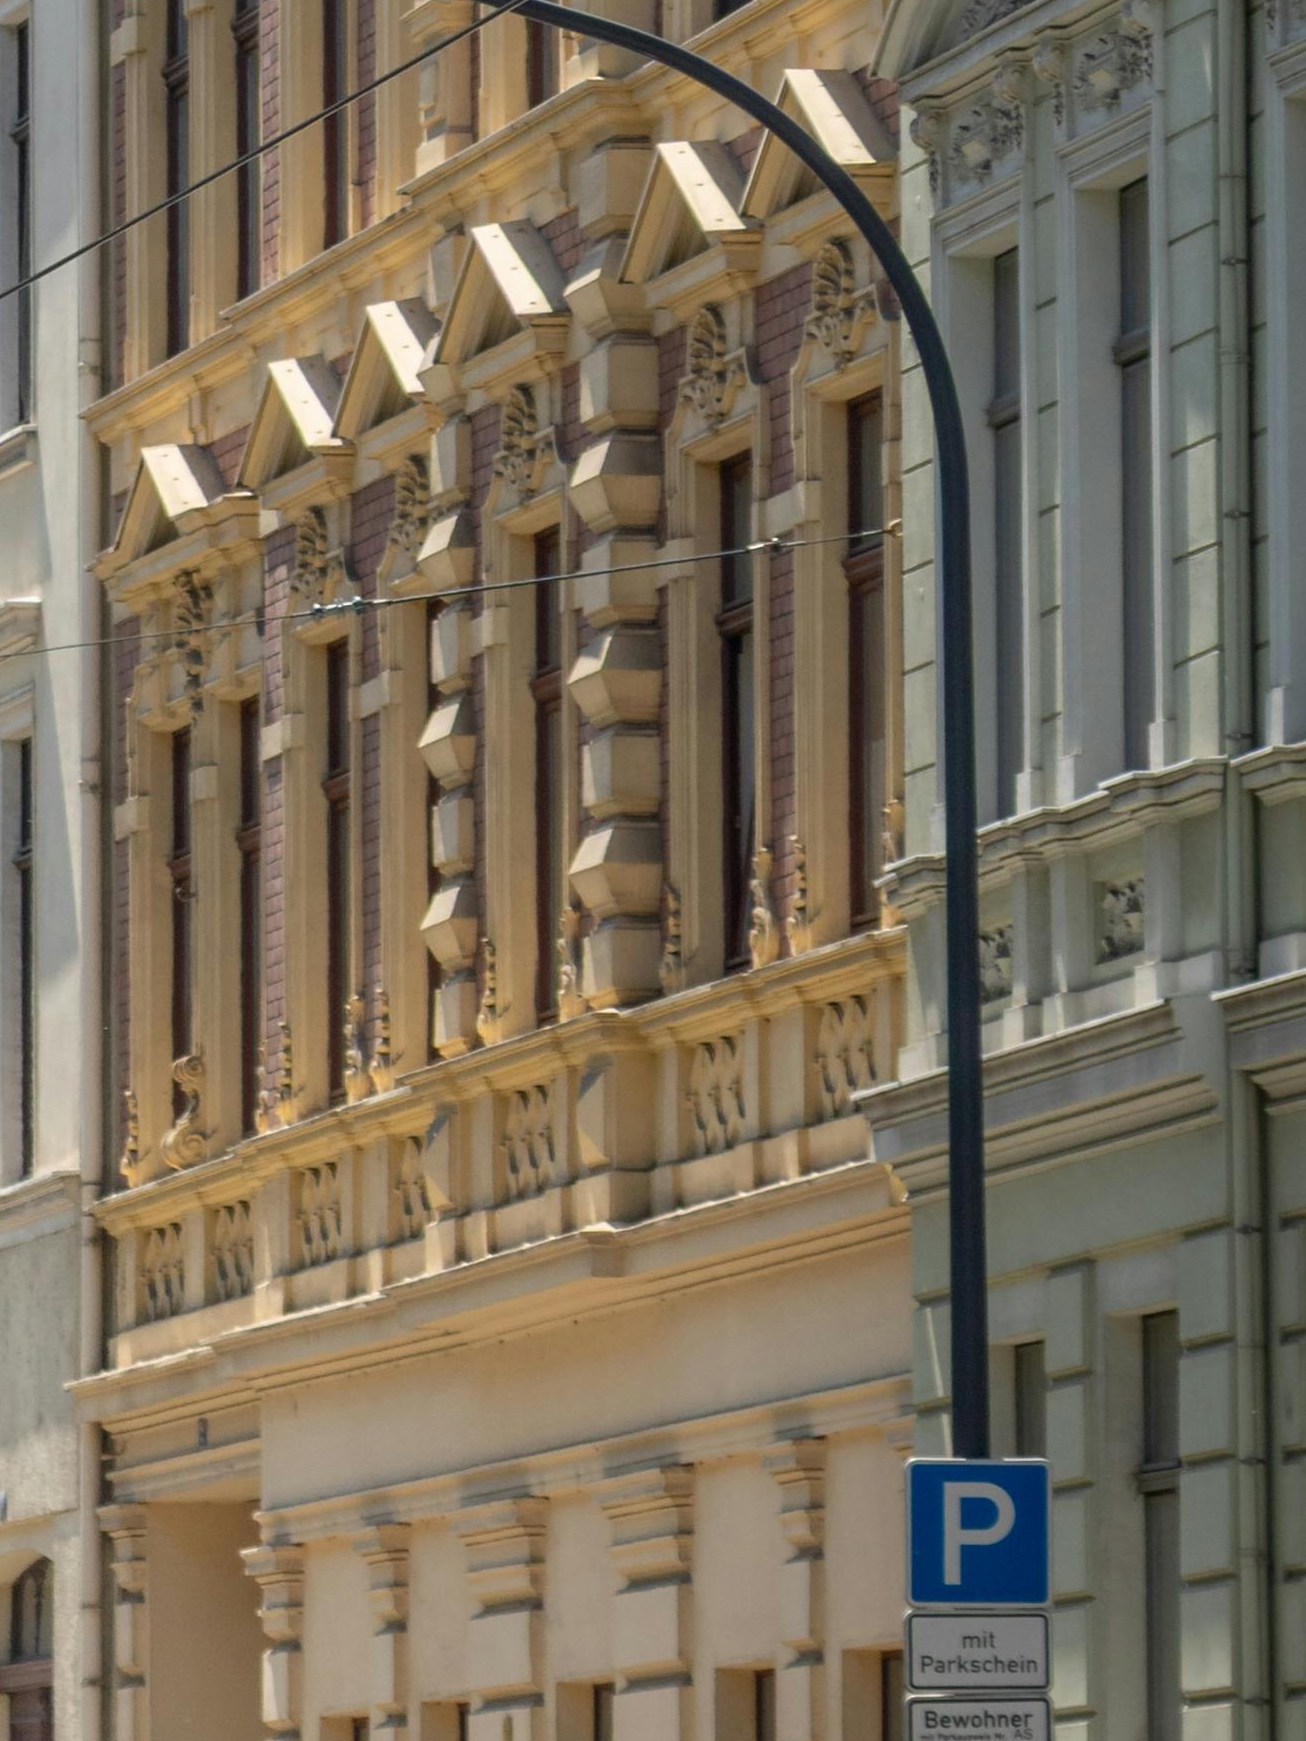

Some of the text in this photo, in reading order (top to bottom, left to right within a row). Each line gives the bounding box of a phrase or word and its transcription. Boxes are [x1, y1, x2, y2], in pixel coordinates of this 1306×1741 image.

[943, 1481, 1016, 1585] P
[962, 1630, 996, 1649] mit
[920, 1655, 1038, 1674] Parkschein
[924, 1709, 1033, 1729] Bewohner
[1013, 1729, 1034, 1740] AS
